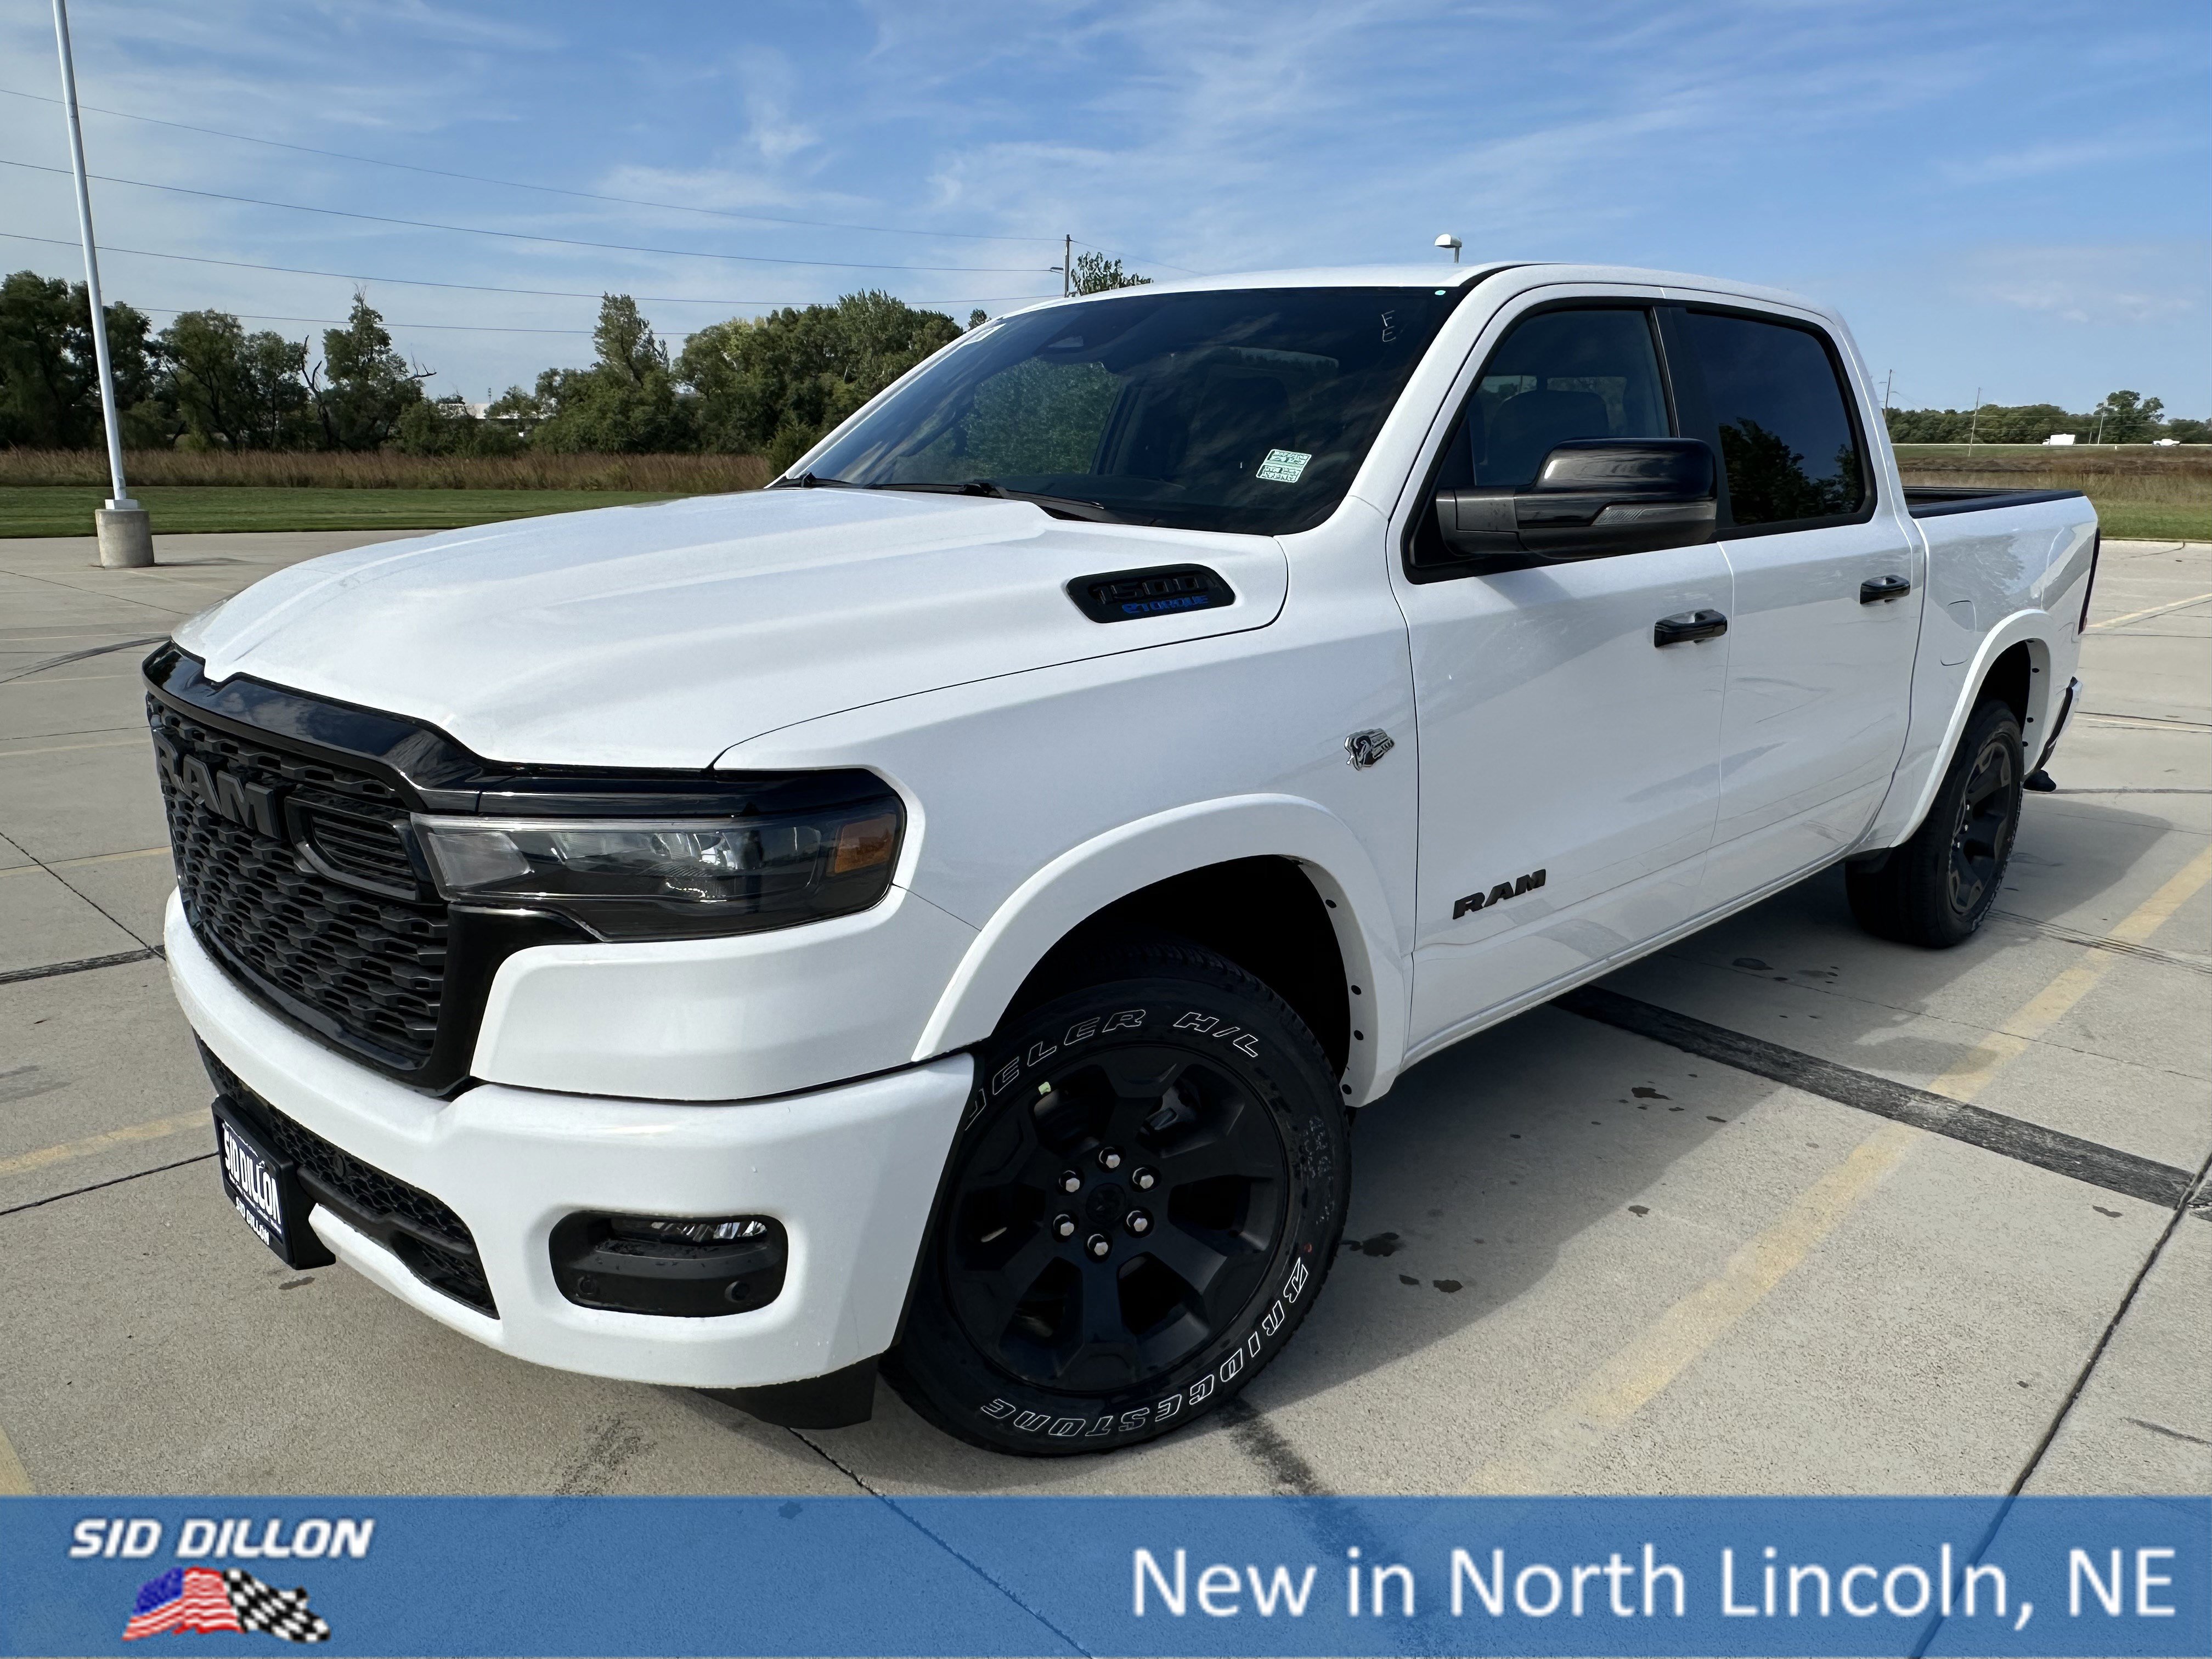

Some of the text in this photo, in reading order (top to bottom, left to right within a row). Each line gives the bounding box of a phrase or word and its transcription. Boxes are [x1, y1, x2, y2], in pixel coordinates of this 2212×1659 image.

[153, 727, 281, 840] RAM
[1452, 868, 1546, 920] RAM
[1172, 1012, 1259, 1058] H/L
[224, 1126, 281, 1224] SID DILLON
[980, 1256, 1309, 1437] BRIDGESTONE
